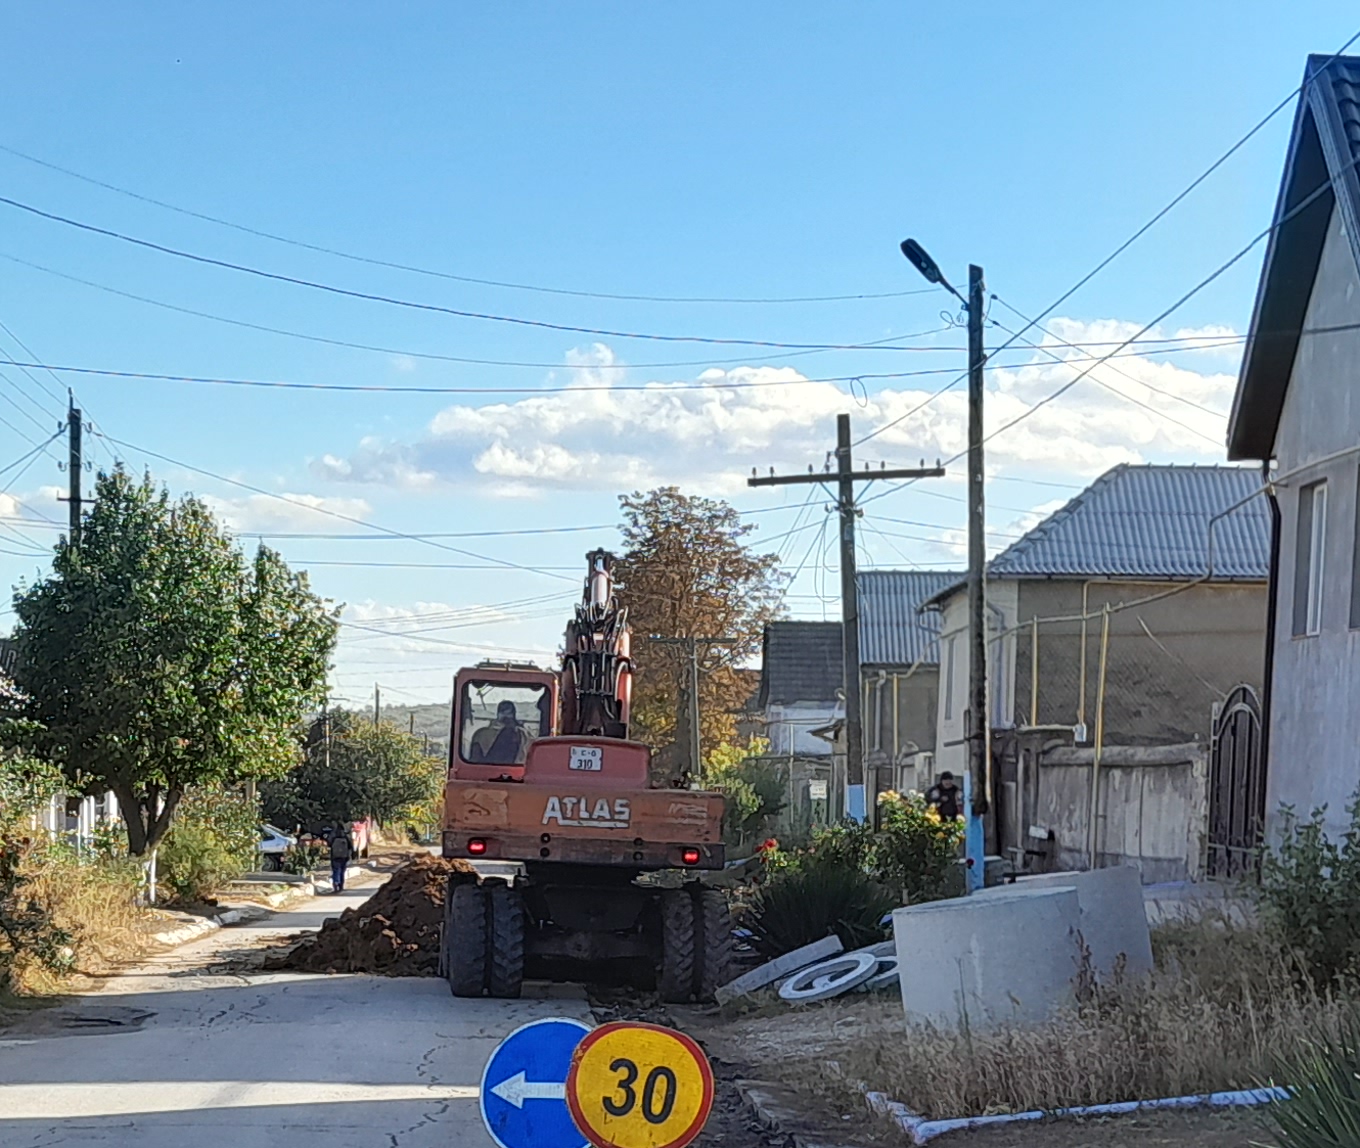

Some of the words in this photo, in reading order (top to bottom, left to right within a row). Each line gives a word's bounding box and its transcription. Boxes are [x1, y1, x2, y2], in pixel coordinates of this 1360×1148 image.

[577, 759, 593, 770] 310
[542, 796, 630, 825] ATLAS
[602, 1057, 677, 1124] 30
